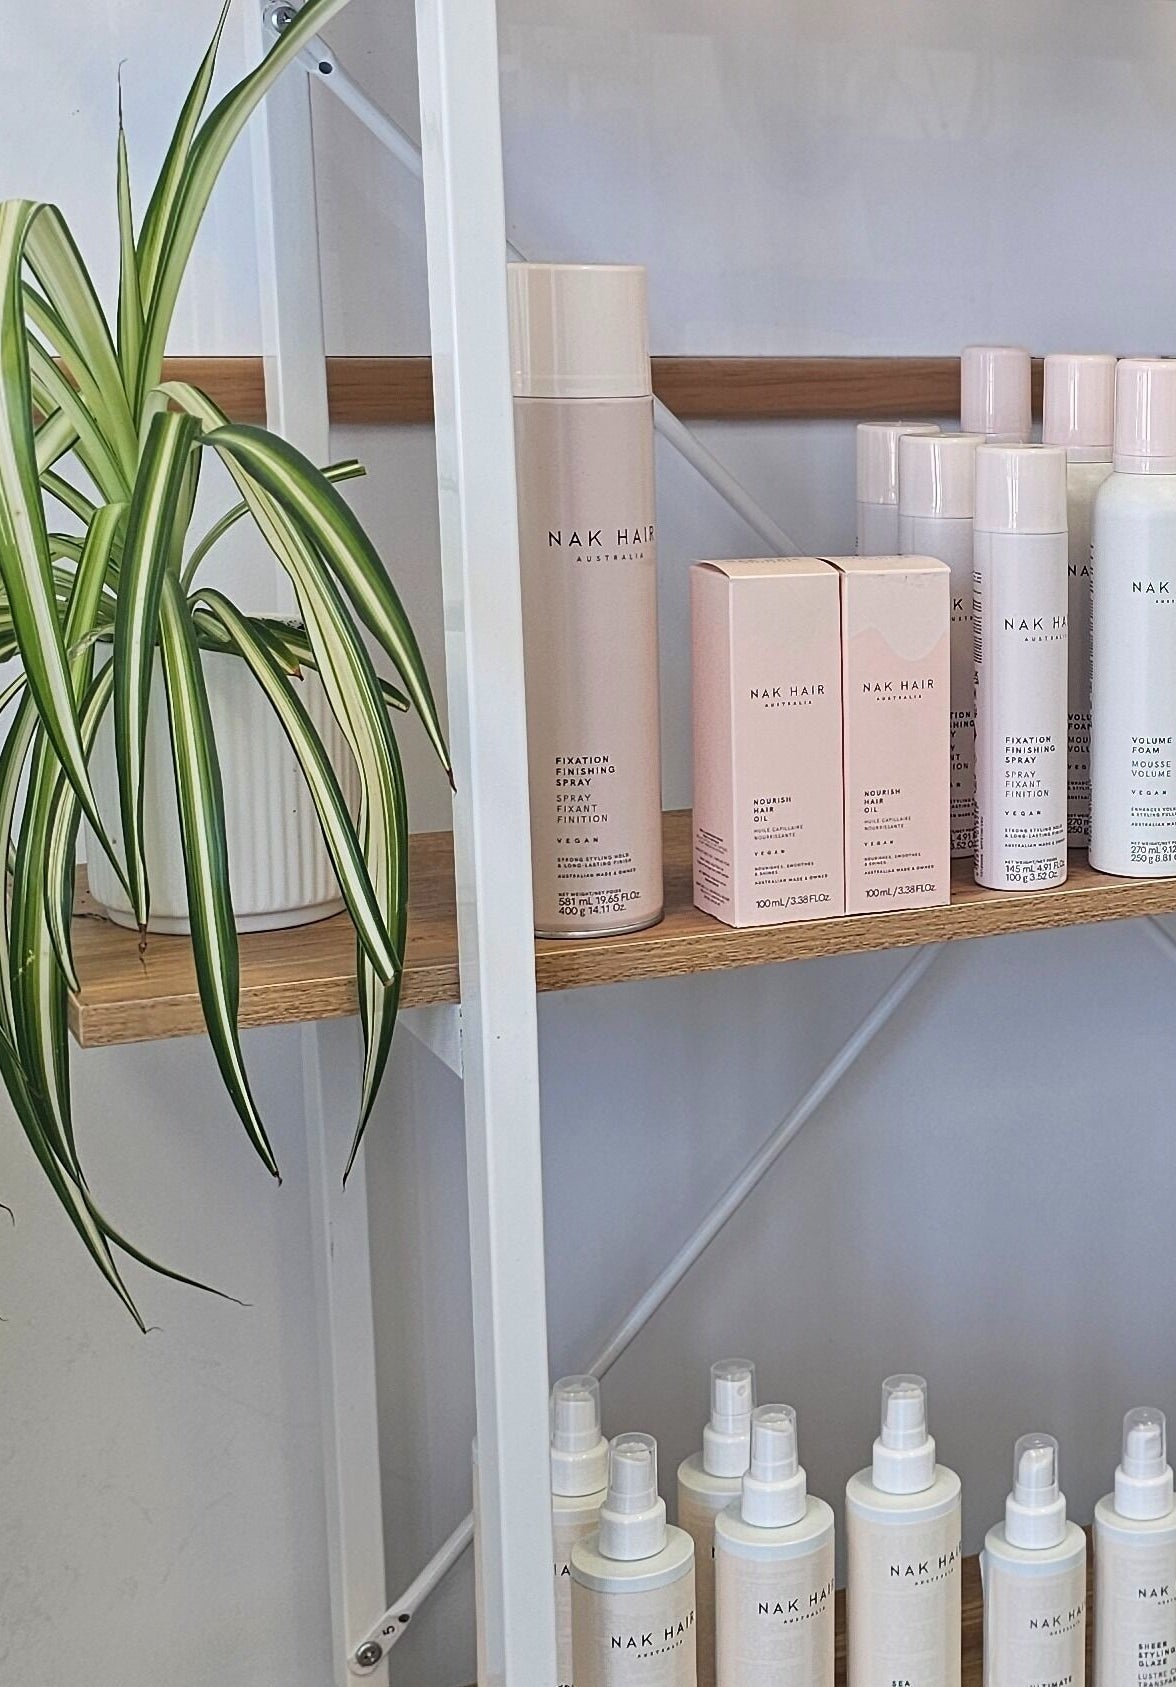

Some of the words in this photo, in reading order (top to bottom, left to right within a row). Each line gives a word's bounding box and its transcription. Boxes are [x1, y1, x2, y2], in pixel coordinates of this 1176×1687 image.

[548, 530, 602, 546] NAK
[617, 525, 655, 545] HAIR
[576, 553, 643, 562] AUSTRALIA
[1132, 581, 1169, 593] NAK
[1005, 617, 1043, 630] NAK
[863, 682, 893, 693] NAK
[900, 679, 934, 690] HAIR
[750, 687, 782, 699] NAK
[790, 684, 825, 697] HAIR
[1005, 736, 1051, 744] FIXATION
[1005, 745, 1056, 754] FINISHING
[556, 756, 609, 764] FIXATION
[1005, 756, 1036, 764] SPRAY
[1132, 760, 1171, 768] MOUSSE
[556, 766, 616, 775] FINISHING
[1132, 770, 1172, 778] VOLUME
[556, 779, 591, 787] SPRAY
[1005, 780, 1041, 788] FIXANT
[864, 789, 901, 797] NOURISH
[1005, 790, 1049, 798] FINITION
[556, 794, 591, 802] SPRAY
[753, 797, 792, 805] NOURISH
[557, 804, 598, 812] FIXANT
[557, 814, 608, 823] FINITION
[1067, 818, 1083, 826] 270
[772, 824, 804, 832] CAPILLAIRE
[1067, 826, 1083, 834] 250
[754, 832, 795, 840] NOURRISSANTE
[1148, 846, 1160, 854] mL
[1162, 845, 1176, 853] 9.12
[1130, 853, 1147, 862] 250
[1037, 863, 1051, 871] 4.91
[1006, 873, 1021, 881] 100
[1030, 872, 1047, 881] 3.52
[865, 889, 879, 897] 100
[558, 897, 576, 906] 581
[578, 897, 593, 905] mL
[596, 894, 619, 905] 19.65
[756, 899, 770, 908] 100
[559, 906, 578, 915] 400
[580, 907, 585, 917] g
[588, 905, 610, 914] 14.11
[890, 1561, 929, 1576] NAK
[1138, 1586, 1169, 1598] NAK
[758, 1598, 799, 1614] NAK
[784, 1606, 825, 1624] AUSTRALIA
[1030, 1615, 1061, 1629] NAK
[611, 1632, 653, 1648] NAK
[1138, 1641, 1167, 1650] SHEER
[1138, 1646, 1176, 1658] STYLING
[1138, 1658, 1167, 1667] GLAZE
[1138, 1670, 1167, 1680] LUSTRE
